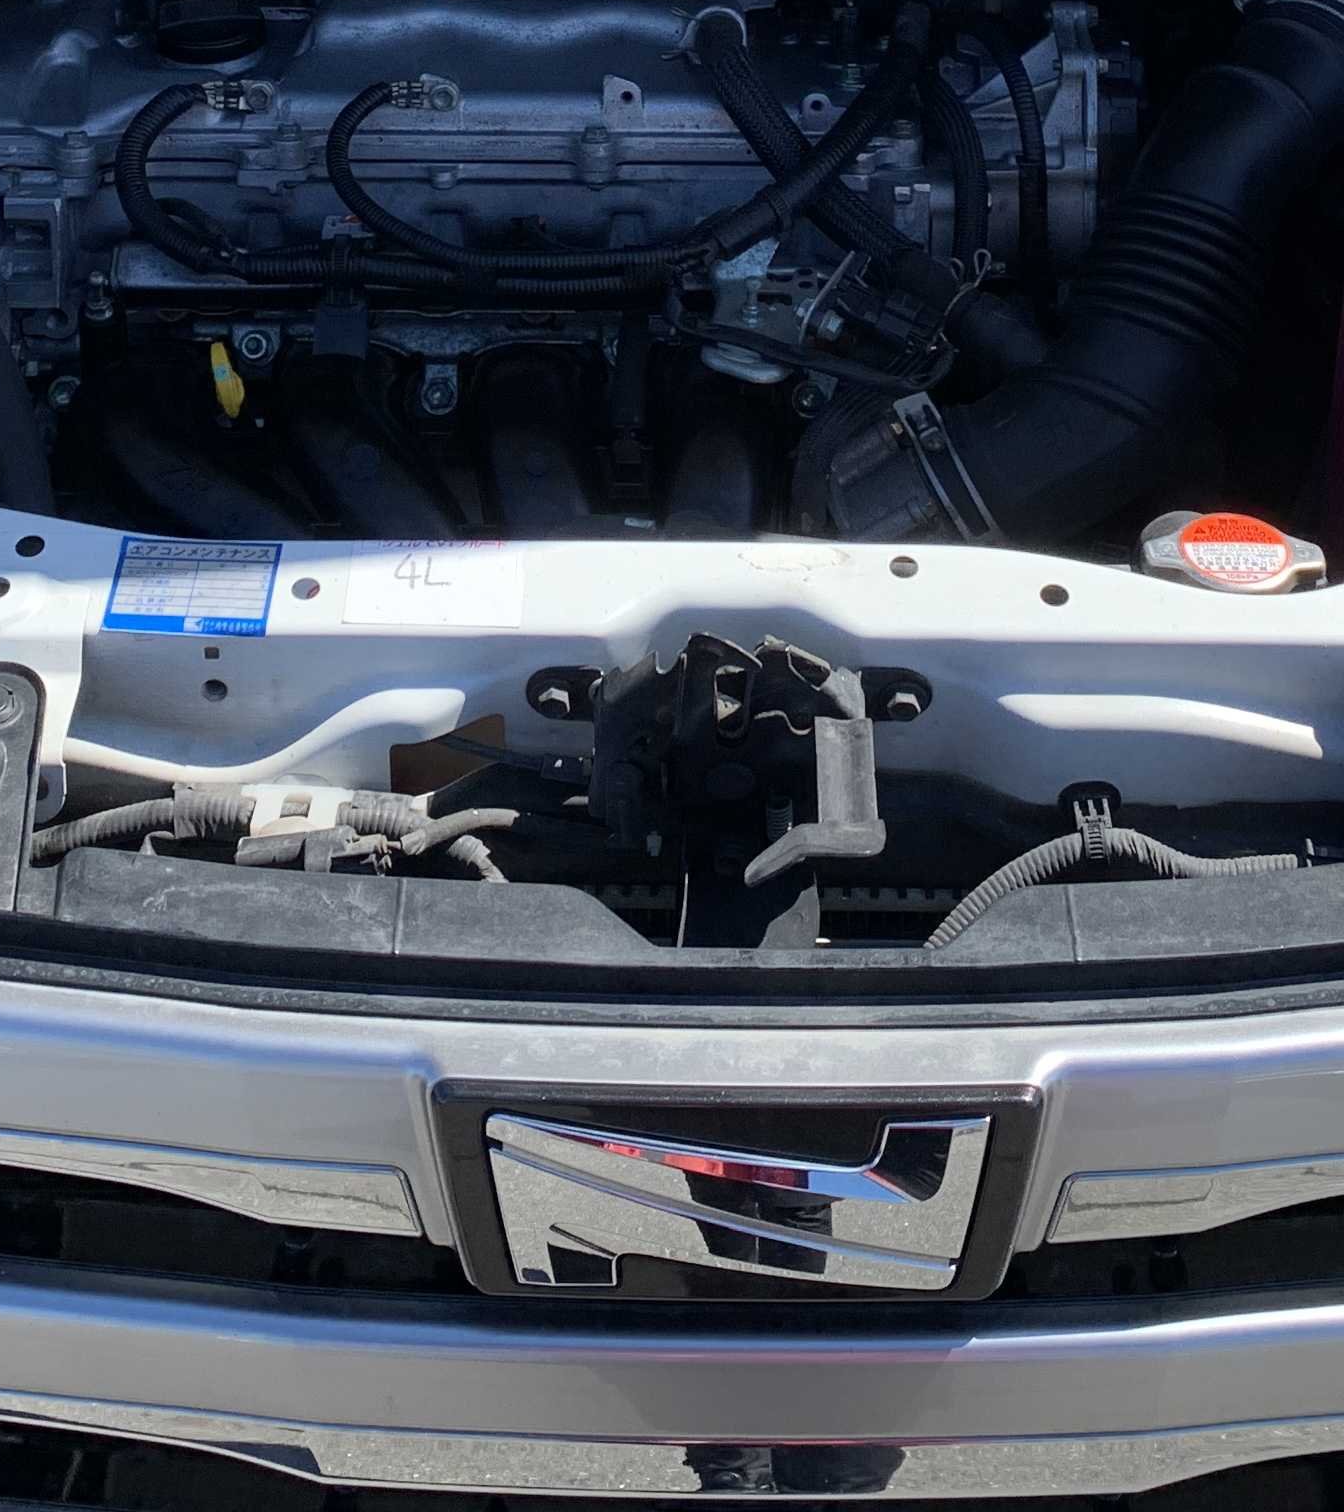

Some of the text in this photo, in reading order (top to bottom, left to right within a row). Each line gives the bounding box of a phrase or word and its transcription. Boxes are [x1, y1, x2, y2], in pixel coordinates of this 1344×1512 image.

[129, 544, 272, 559] エアコンメンテナンス
[394, 552, 452, 589] 4L
